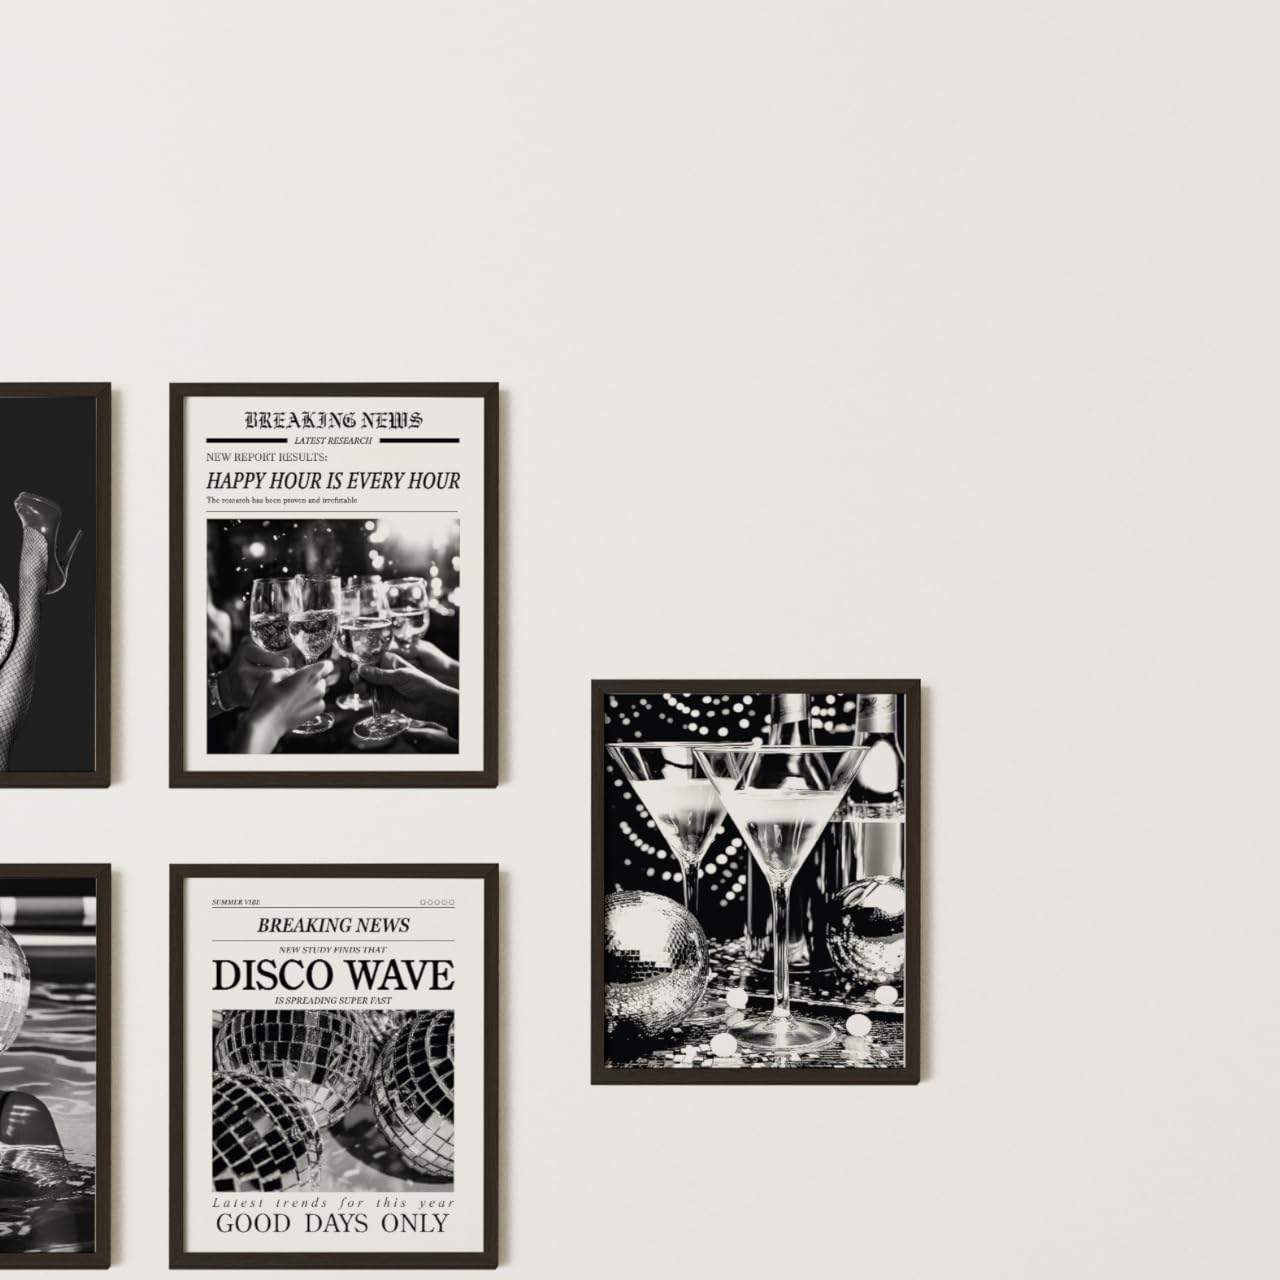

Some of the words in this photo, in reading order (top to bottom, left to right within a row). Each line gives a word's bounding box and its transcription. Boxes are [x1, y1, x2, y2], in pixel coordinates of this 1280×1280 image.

[245, 411, 357, 430] BREAKING
[360, 411, 424, 430] NEWS
[294, 436, 327, 445] LATEST
[328, 436, 373, 445] RESEARCH
[206, 452, 231, 462] NEW
[233, 452, 277, 462] REPORT
[278, 452, 328, 462] RESULTS:
[206, 471, 267, 490] HAPPY
[269, 471, 322, 490] HOUR
[326, 471, 344, 490] IS
[346, 471, 406, 490] EVERY
[407, 471, 461, 490] HOUR
[206, 496, 220, 504] The
[221, 496, 250, 504] research
[251, 496, 264, 504] has
[265, 496, 282, 504] been
[308, 496, 321, 504] and
[322, 496, 358, 504] irrefutable
[257, 917, 352, 934] BREAKING
[355, 917, 410, 934] NEWS
[279, 946, 300, 954] NEW
[302, 946, 332, 954] STUDY
[333, 946, 361, 954] FINDS
[362, 946, 388, 954] THAT
[212, 958, 334, 991] DISCO
[343, 958, 456, 991] WAVE
[274, 996, 284, 1005] IS
[285, 996, 338, 1005] SPREADING
[338, 996, 369, 1005] SUPER
[369, 996, 393, 1005] FAST
[211, 1197, 263, 1208] Latest
[276, 1197, 328, 1208] trends
[338, 1197, 364, 1211] for
[376, 1197, 407, 1208] this
[418, 1200, 455, 1211] year
[216, 1212, 291, 1234] GOOD
[305, 1212, 369, 1234] DAYS
[381, 1212, 450, 1234] ONLY
